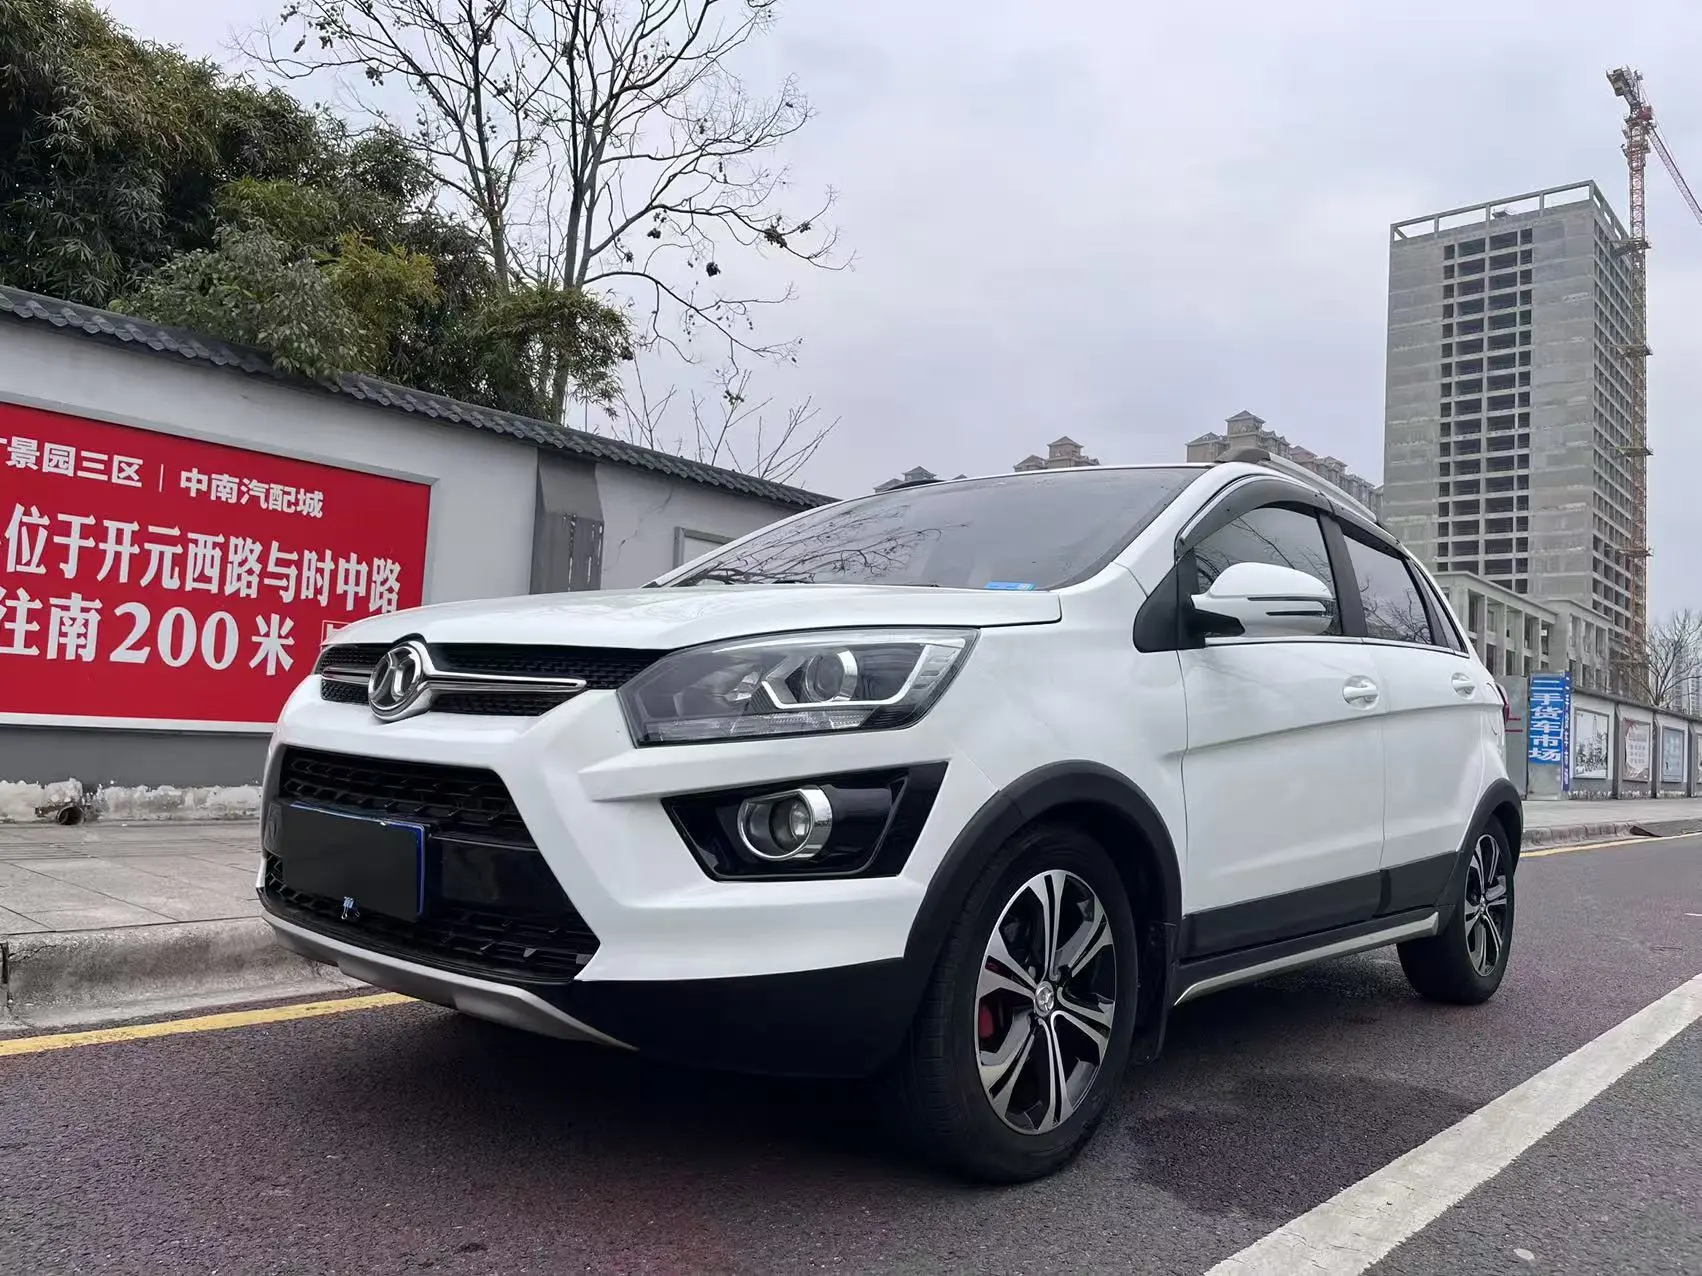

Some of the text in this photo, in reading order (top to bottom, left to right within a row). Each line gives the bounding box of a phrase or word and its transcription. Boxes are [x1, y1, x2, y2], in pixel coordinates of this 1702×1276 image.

[0, 436, 324, 518] 景园三区 中南汽配城
[5, 503, 401, 614] 位于开元西路与时中路
